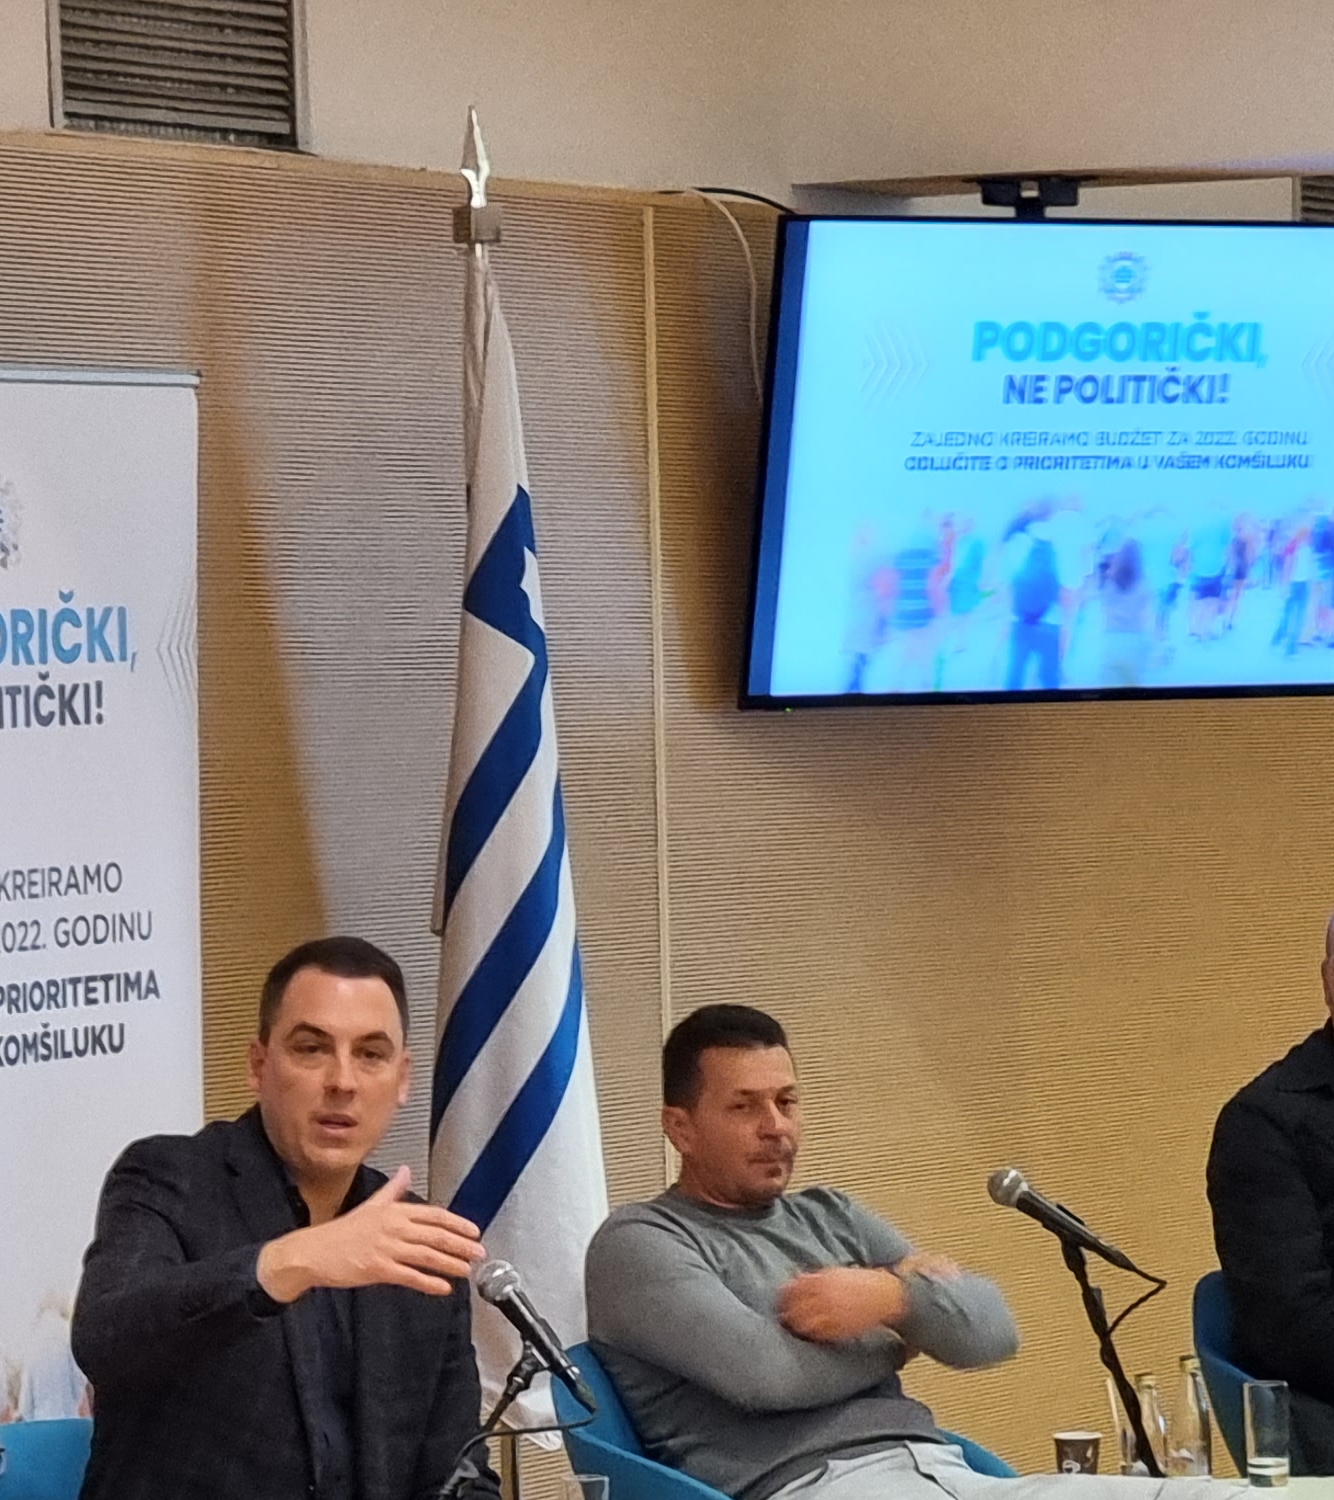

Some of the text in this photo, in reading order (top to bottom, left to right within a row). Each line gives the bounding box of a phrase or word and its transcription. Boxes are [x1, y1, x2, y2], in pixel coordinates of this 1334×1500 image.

[971, 311, 1267, 368] PODGORIČKI,
[1002, 367, 1231, 405] NE POLITIČKI!
[54, 911, 153, 948] GODINU
